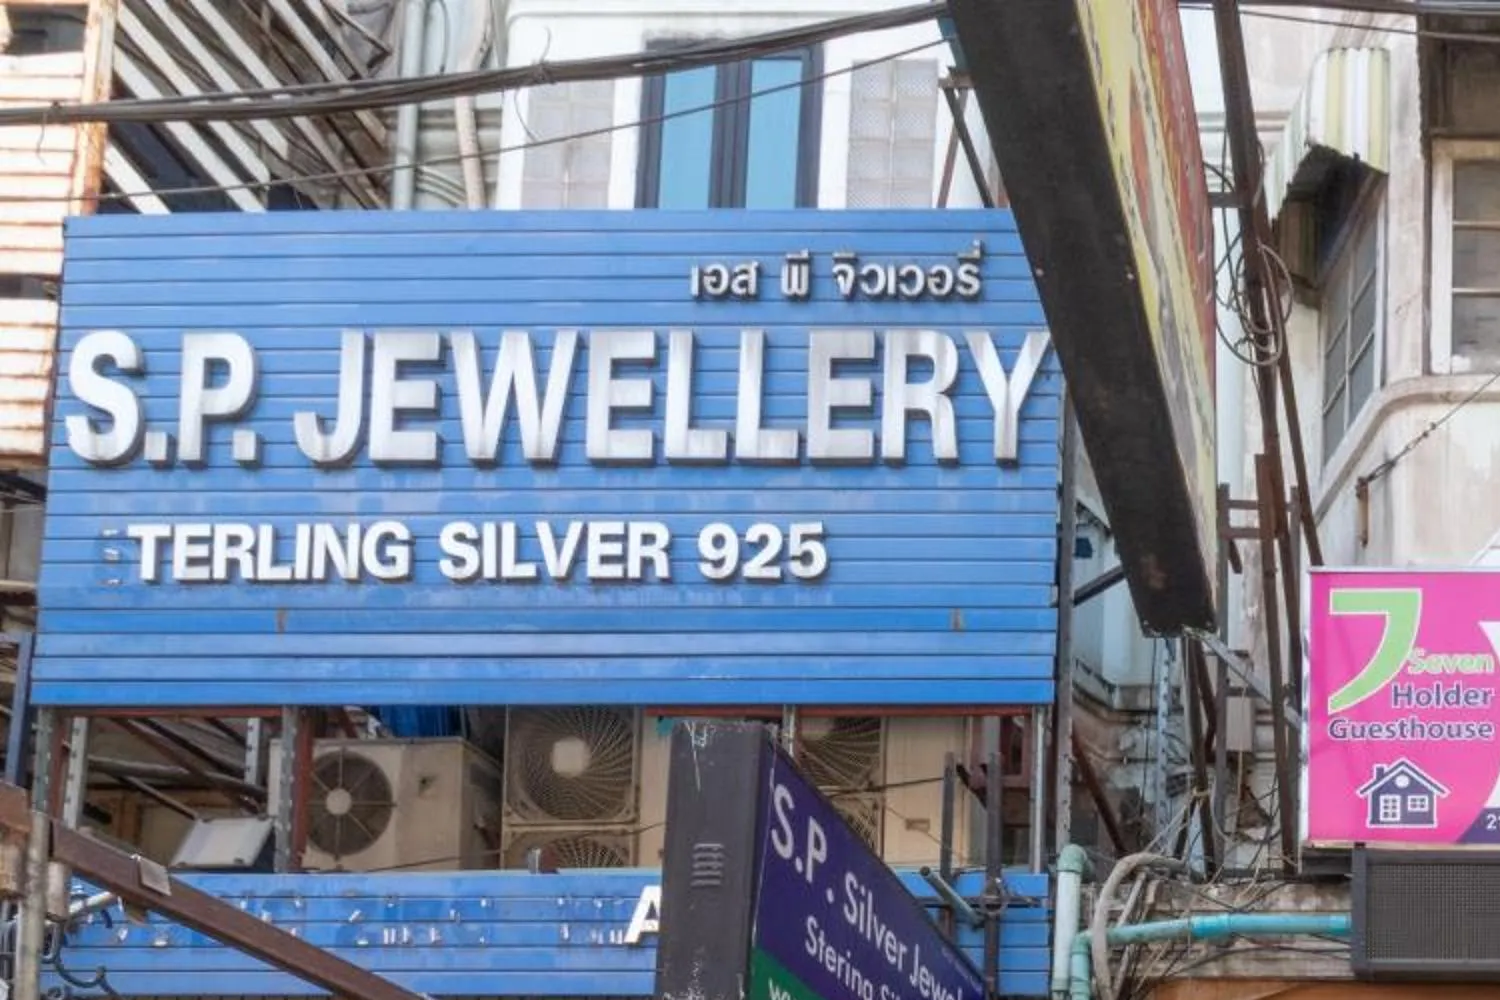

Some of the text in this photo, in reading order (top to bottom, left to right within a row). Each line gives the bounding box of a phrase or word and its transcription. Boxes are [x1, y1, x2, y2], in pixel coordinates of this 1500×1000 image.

[690, 261, 759, 297] เอส
[781, 247, 810, 297] พี
[65, 328, 1051, 465] S.P. JEWELLERY
[438, 521, 671, 583] SILVER
[697, 520, 828, 582] 925
[1328, 588, 1423, 714] 7
[1408, 648, 1494, 674] Seven
[1392, 682, 1495, 707] Holder
[1329, 718, 1493, 740] Guesthouse
[843, 871, 907, 971] Silver
